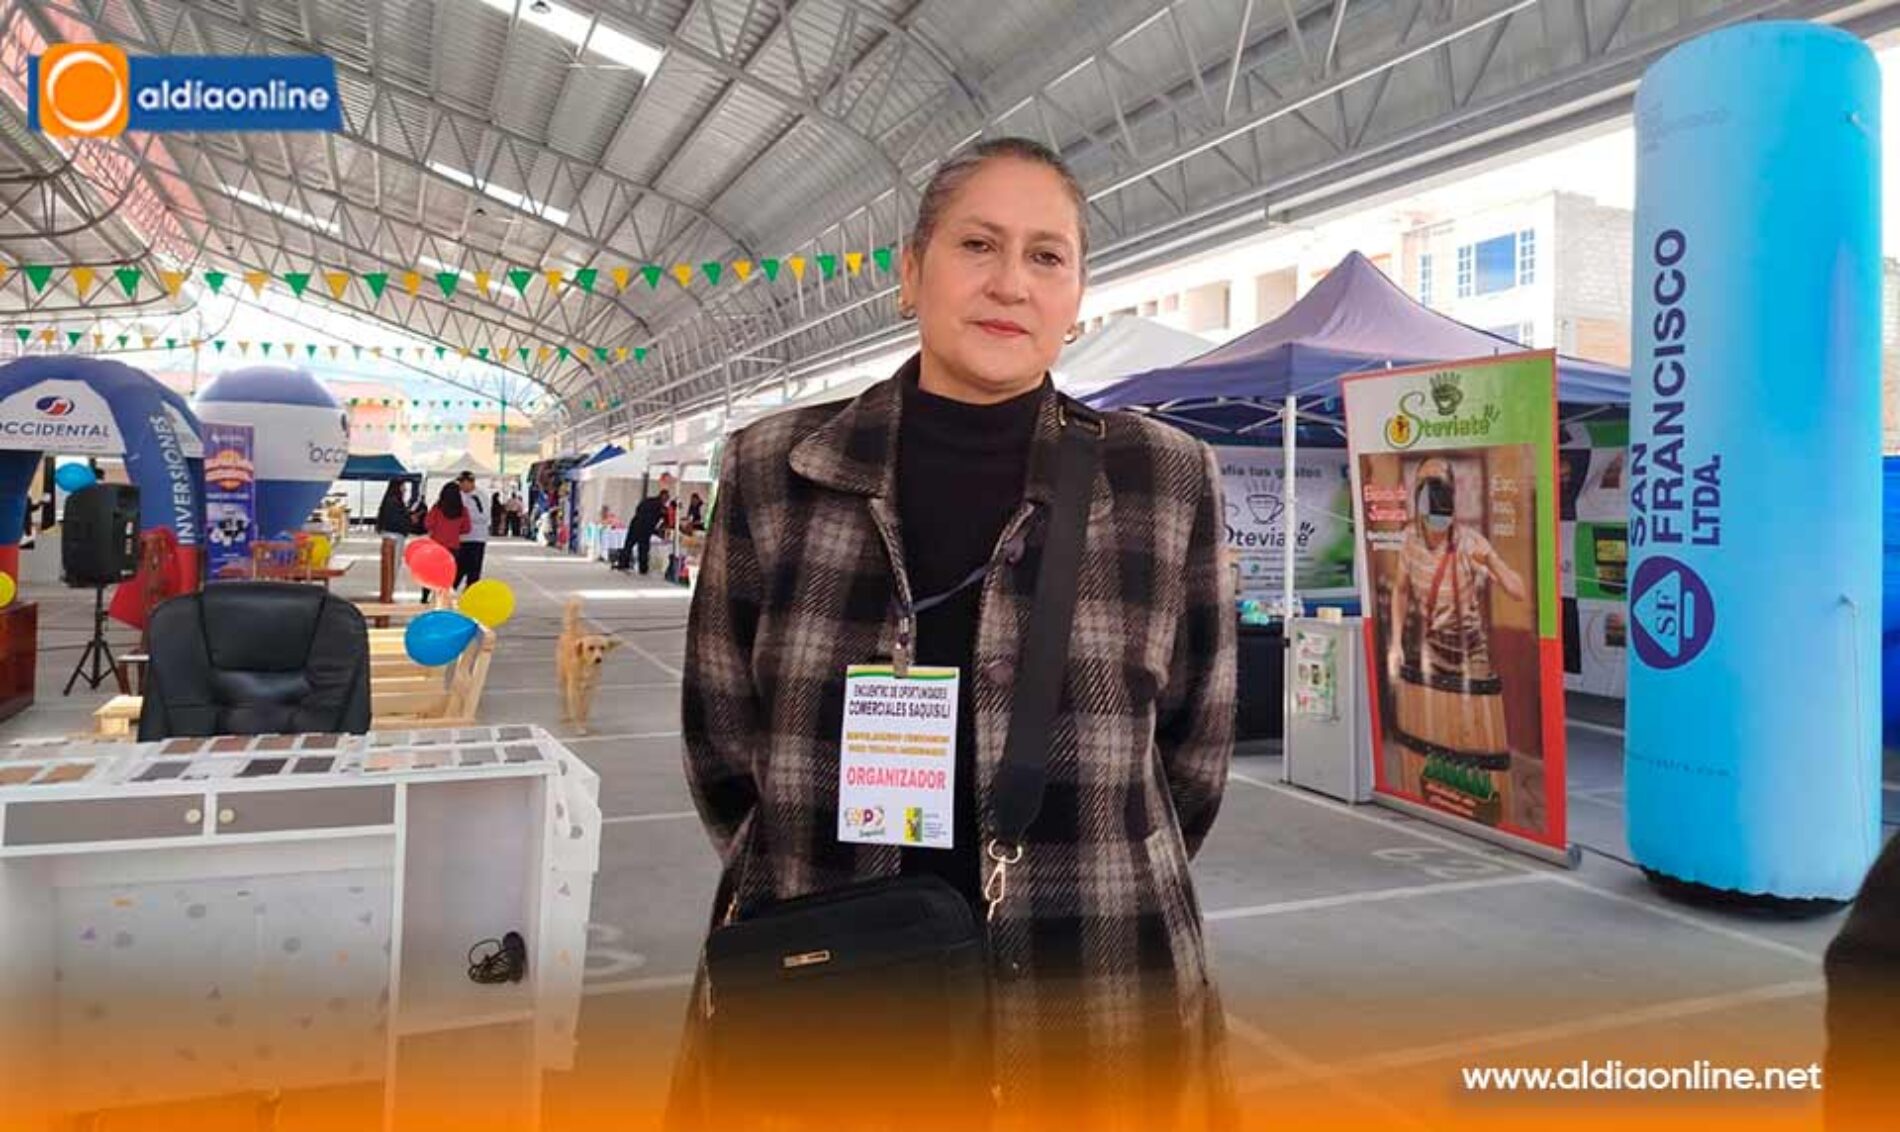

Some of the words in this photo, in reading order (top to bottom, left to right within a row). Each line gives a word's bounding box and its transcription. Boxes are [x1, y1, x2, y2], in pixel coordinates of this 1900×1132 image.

[1652, 228, 1687, 545] FRANCISCO
[0, 421, 110, 438] CCIDENTAL
[149, 414, 196, 546] INVERSIONES
[1628, 443, 1648, 547] SAN
[1655, 588, 1678, 637] SF
[849, 700, 907, 718] COMERCIALES
[846, 765, 947, 790] ORGANIZADOR
